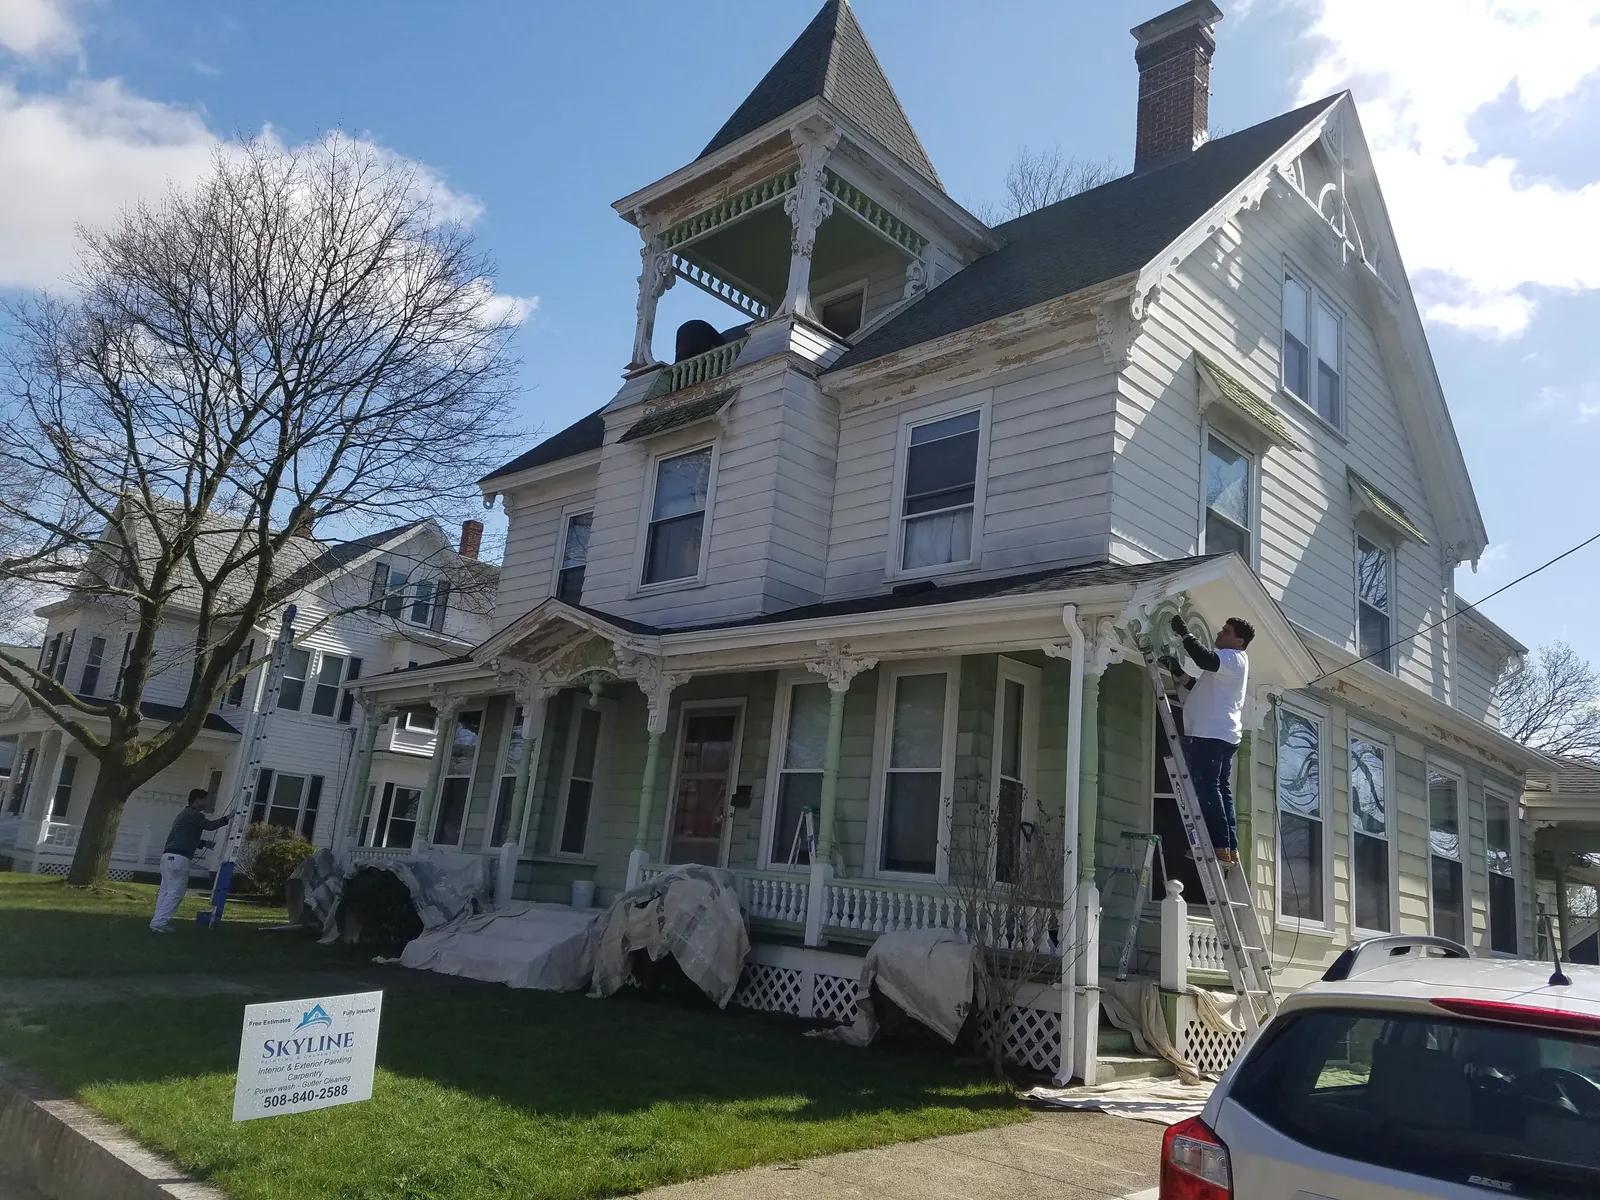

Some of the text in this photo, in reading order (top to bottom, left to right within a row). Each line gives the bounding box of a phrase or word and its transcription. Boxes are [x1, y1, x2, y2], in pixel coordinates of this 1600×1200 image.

[649, 715, 658, 727] 17
[342, 1007, 376, 1018] Fully Insured
[263, 1017, 291, 1026] Estimates
[262, 1031, 355, 1059] SKYLINE
[258, 1055, 353, 1075] Interior & Exterior Painting
[287, 1069, 324, 1082] Carpentry
[254, 1086, 277, 1096] Power
[278, 1083, 296, 1092] wash
[301, 1079, 323, 1089] Gutter
[323, 1074, 352, 1086] Cleaning
[263, 1084, 349, 1108] 508-840-2588
